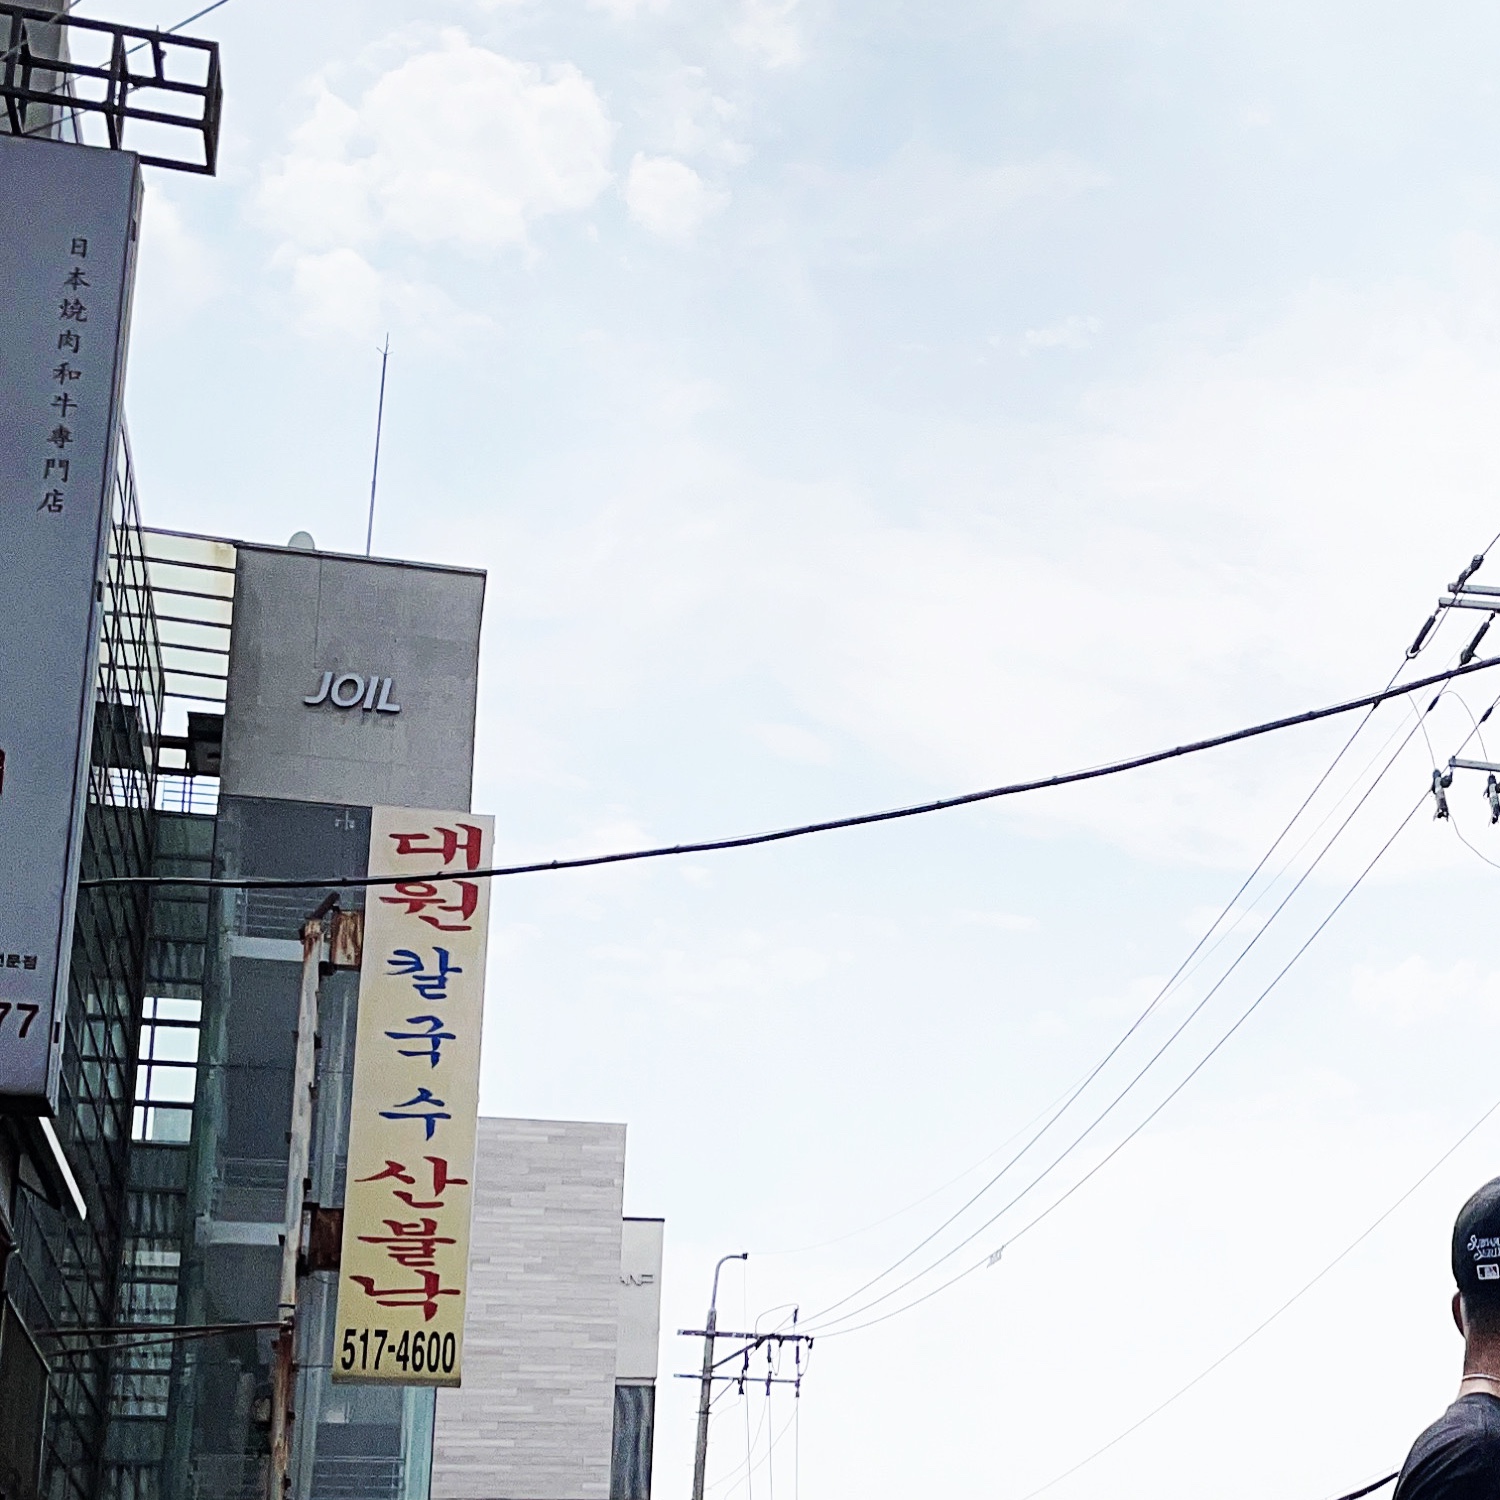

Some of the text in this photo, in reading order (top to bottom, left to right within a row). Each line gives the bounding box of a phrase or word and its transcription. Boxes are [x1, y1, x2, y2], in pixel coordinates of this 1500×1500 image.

[303, 671, 401, 713] JOIL
[379, 946, 462, 1141] 칼국수
[341, 1328, 456, 1374] 517-4600
